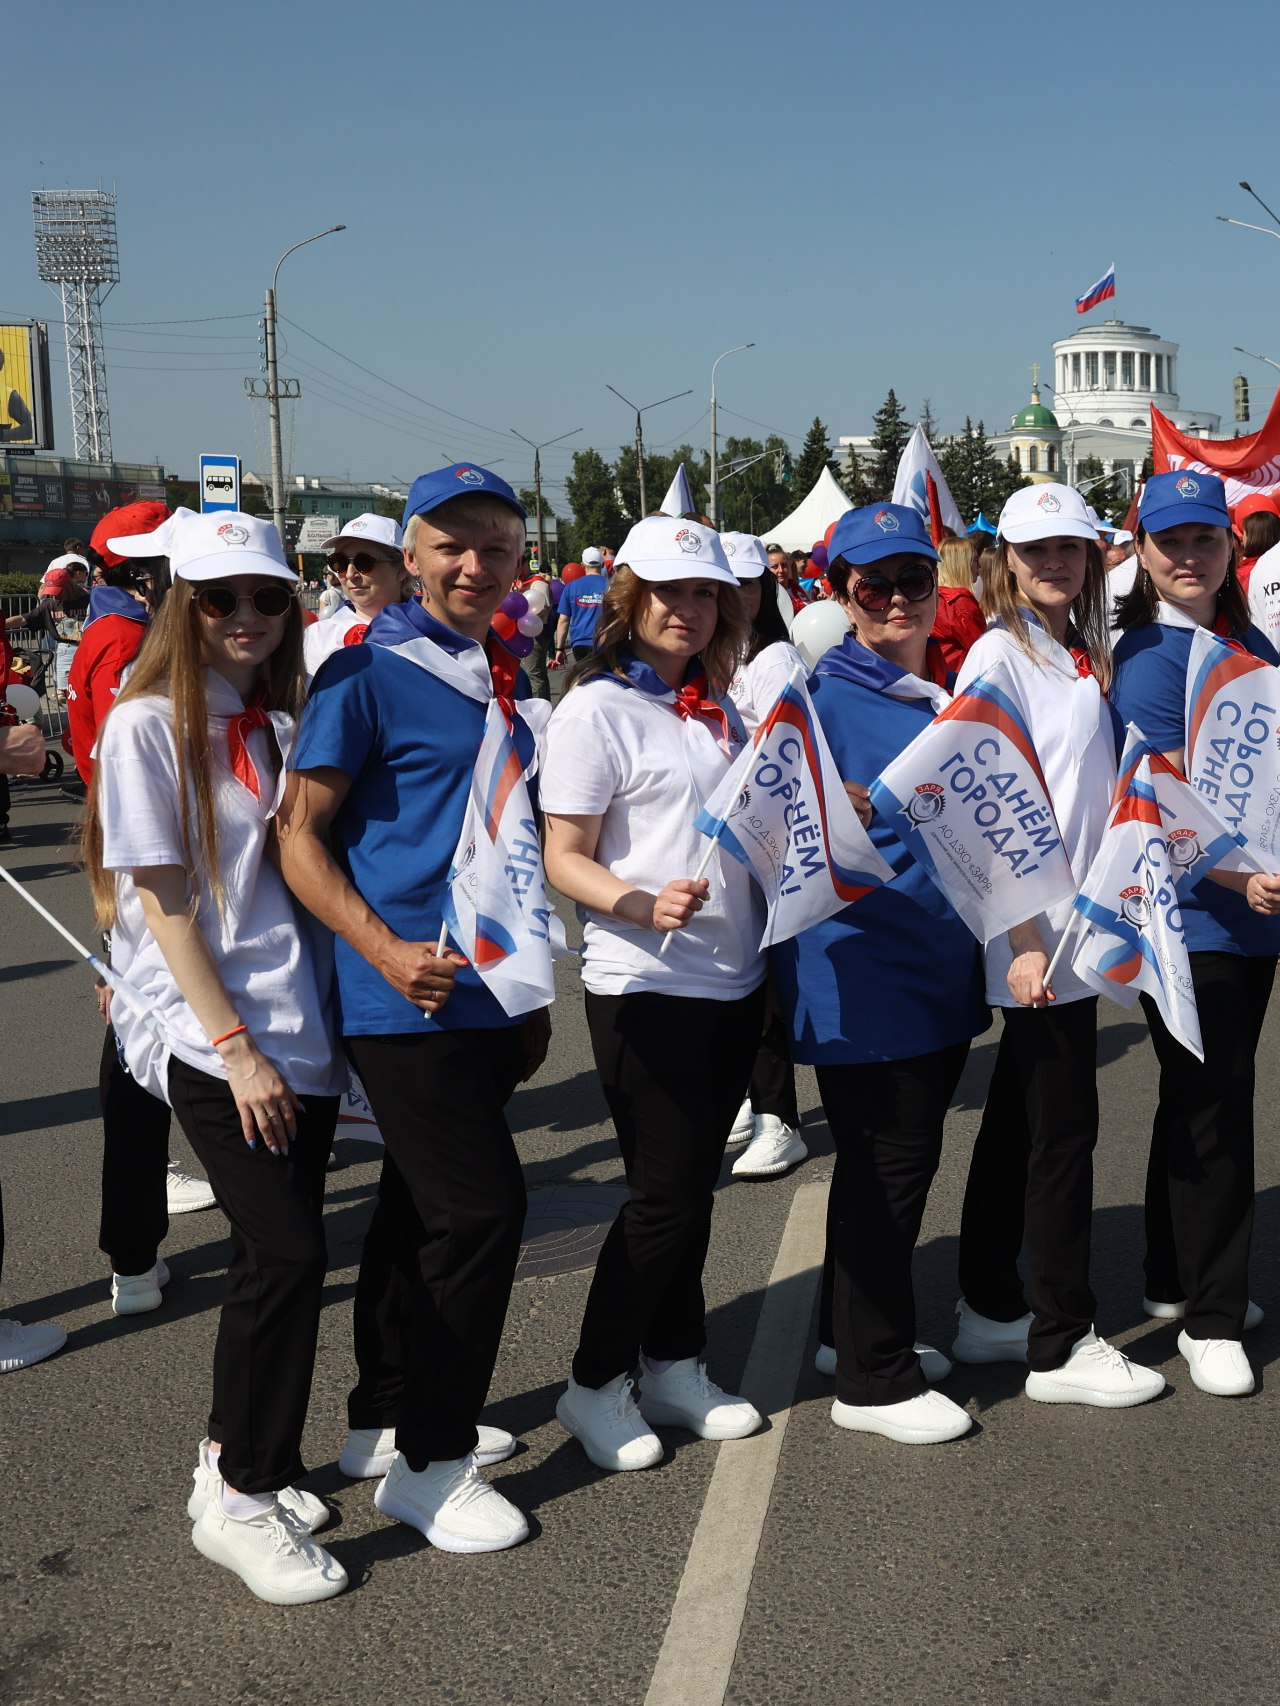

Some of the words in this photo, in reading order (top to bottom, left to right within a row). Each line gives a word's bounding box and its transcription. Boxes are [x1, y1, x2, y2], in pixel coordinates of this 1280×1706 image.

[778, 737, 801, 765] С
[974, 738, 1001, 766] С
[918, 784, 942, 794] ЗАРЯ
[939, 751, 1040, 880] ГОРОДА!
[985, 772, 1061, 858] ДНЁМ
[745, 815, 763, 829] АО
[758, 829, 781, 860] ДЗХО
[938, 824, 954, 839] АО
[948, 839, 972, 864] ДЗХО
[968, 864, 993, 895] «ЗАРЯ»
[1122, 887, 1145, 898] ЗАРЯ
